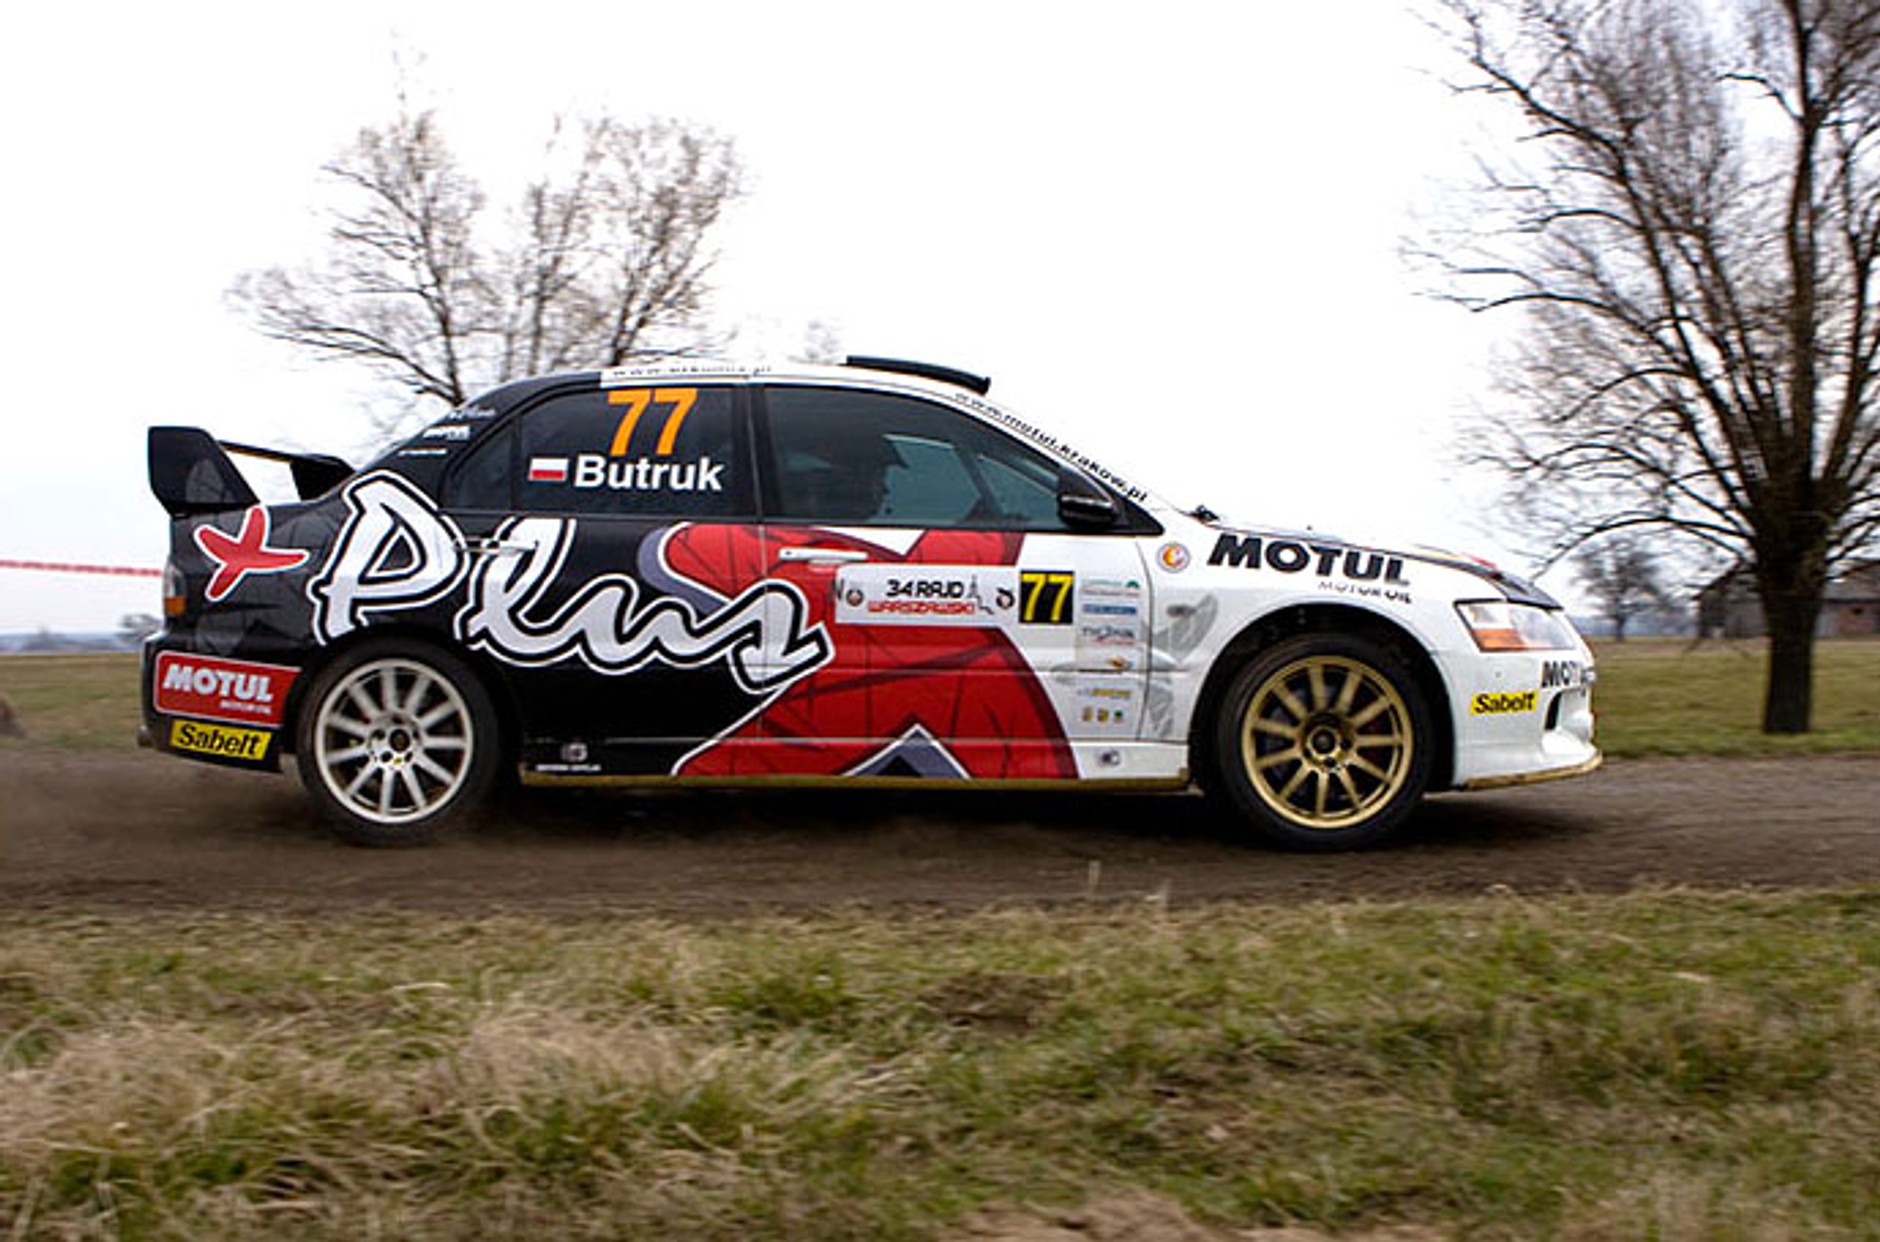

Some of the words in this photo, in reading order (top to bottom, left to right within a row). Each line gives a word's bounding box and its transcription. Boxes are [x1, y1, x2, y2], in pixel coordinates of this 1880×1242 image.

[608, 387, 698, 457] 77
[573, 454, 725, 491] Butruk
[1206, 532, 1411, 587] MOTUL
[306, 469, 836, 695] Plus
[885, 578, 913, 598] 34
[915, 579, 965, 599] RAJD
[1020, 572, 1074, 623] 77
[162, 663, 274, 702] MOTUL
[1474, 692, 1536, 714] Sabelt
[177, 723, 261, 756] Sabelt
